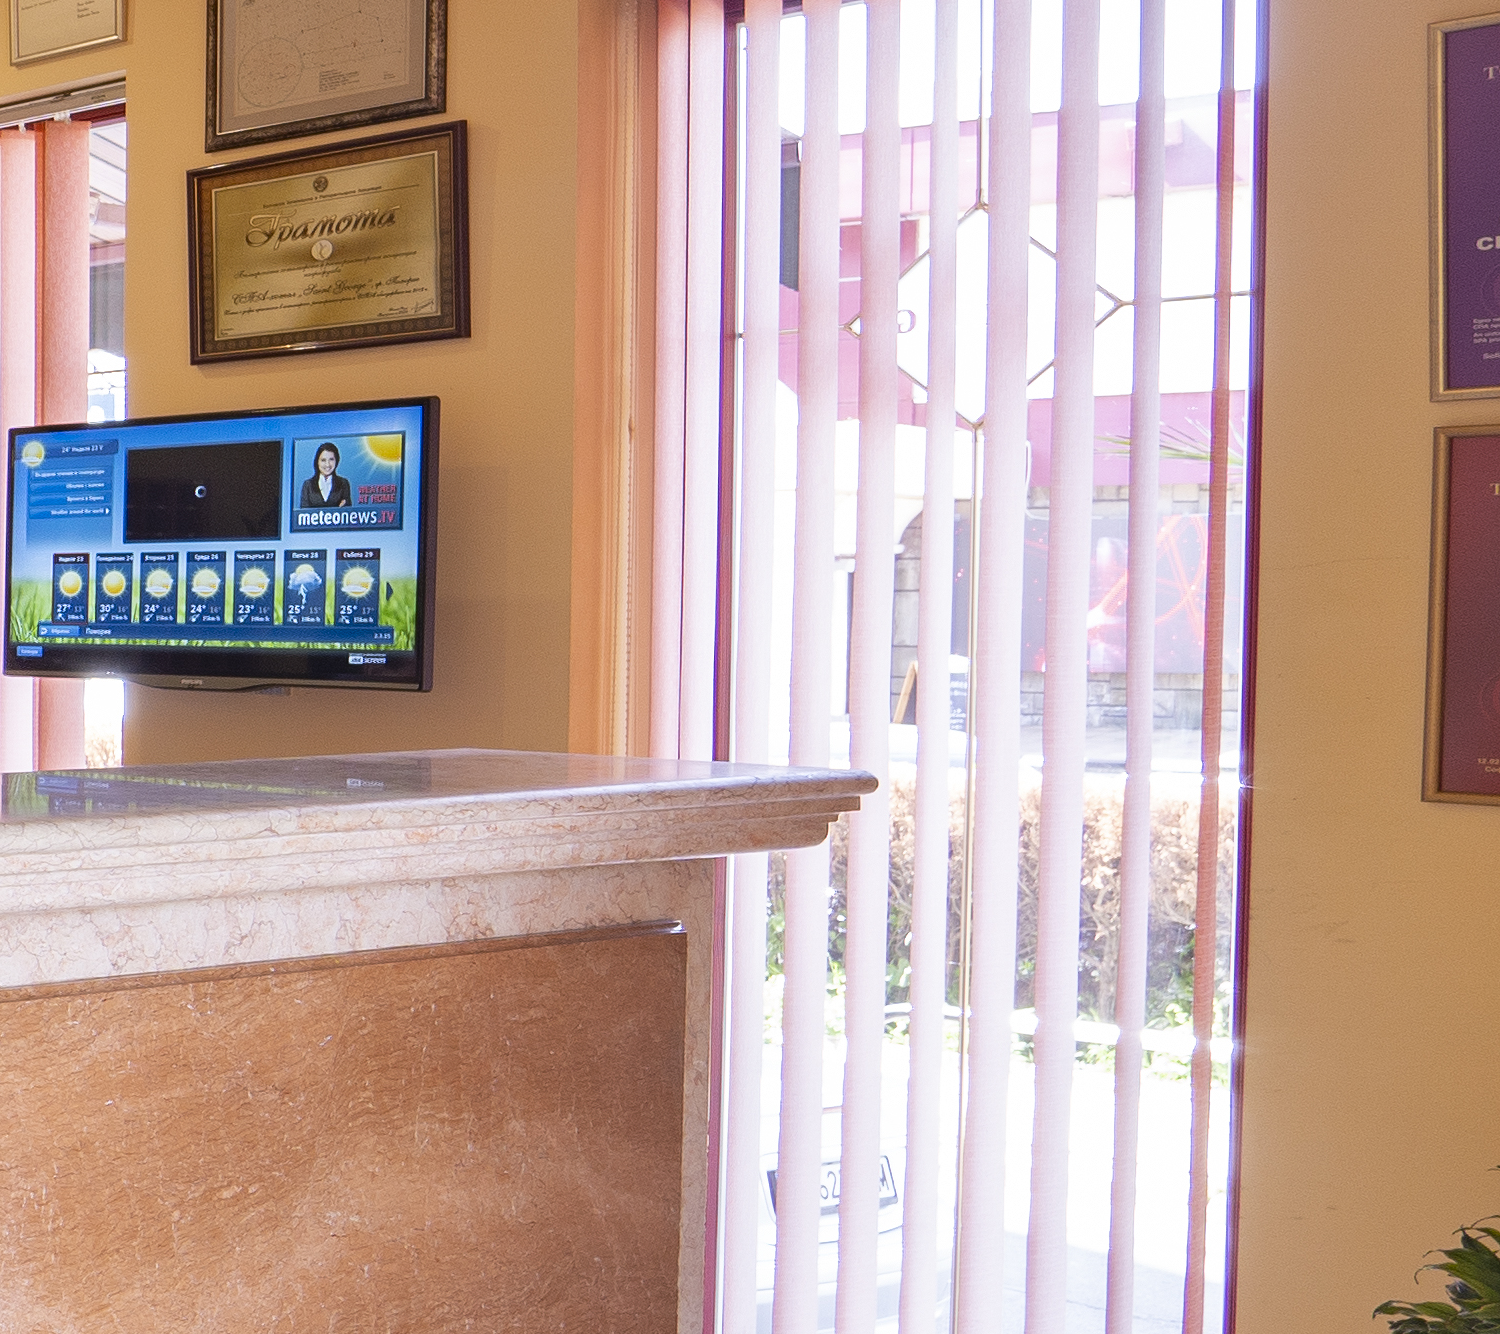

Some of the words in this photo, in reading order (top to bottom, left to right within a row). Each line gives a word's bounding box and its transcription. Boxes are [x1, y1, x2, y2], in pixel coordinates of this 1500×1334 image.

[246, 206, 400, 250] Грамота
[298, 510, 395, 525] meteonews.TV
[56, 604, 71, 613] 27°
[100, 604, 114, 613] 30°
[144, 604, 159, 613] 24°
[190, 604, 206, 613] 24°
[239, 605, 255, 614] 23°
[288, 605, 305, 614] 25°
[340, 605, 357, 614] 25°
